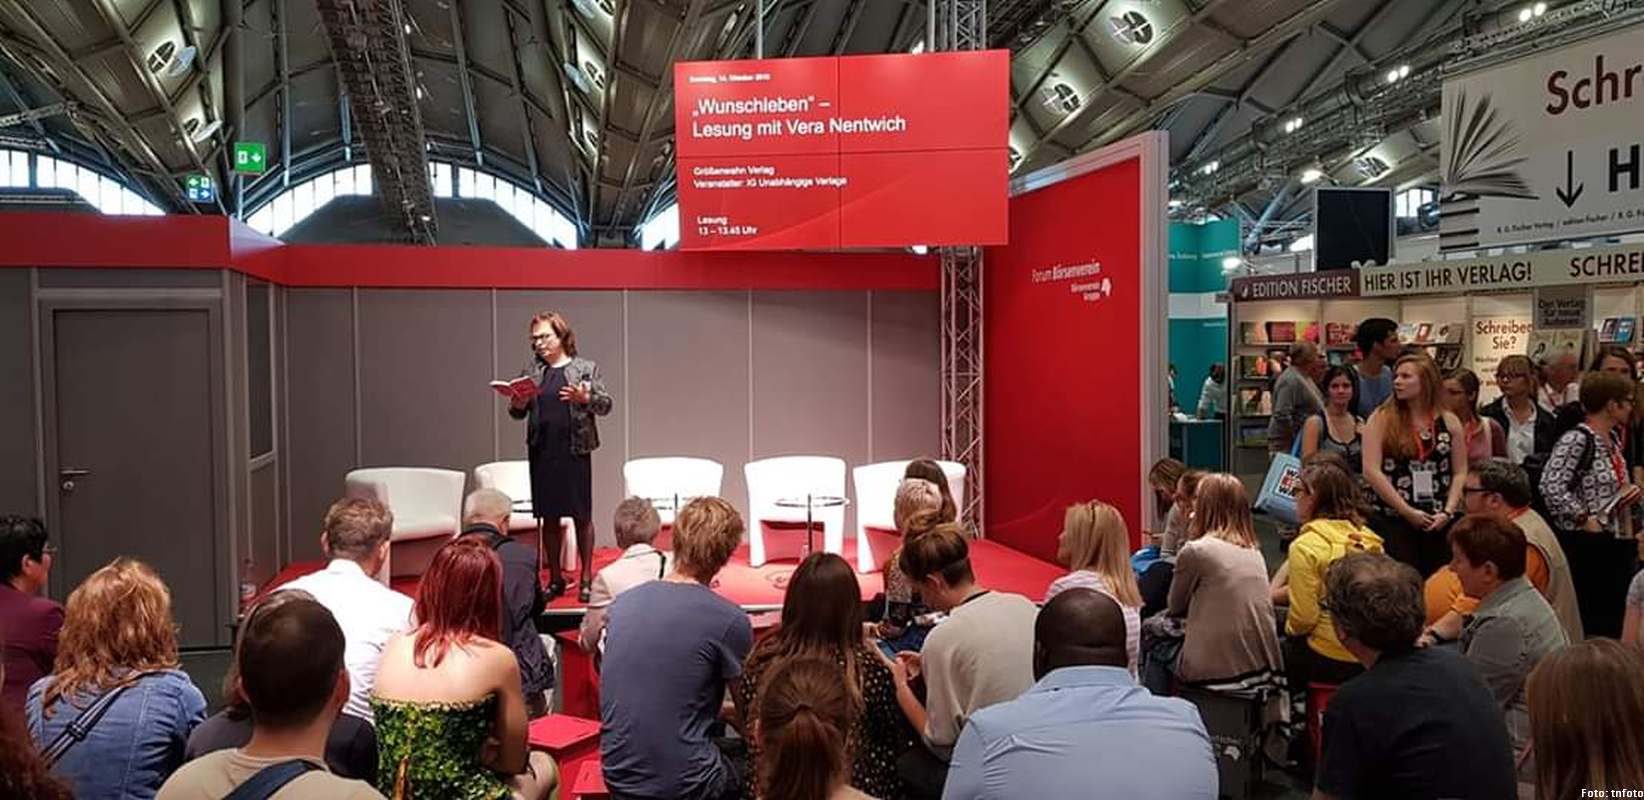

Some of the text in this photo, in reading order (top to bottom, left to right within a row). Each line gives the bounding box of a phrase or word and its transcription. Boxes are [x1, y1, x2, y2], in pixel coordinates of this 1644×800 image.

[1546, 54, 1643, 115] Schr
[692, 114, 906, 140] Lesung mit Vera Nentwich
[693, 165, 775, 177] Größenwahn Verlag
[1609, 144, 1641, 192] H
[758, 177, 813, 188] Unabhängige
[815, 176, 848, 188] Verlage
[697, 215, 728, 226] Lesung
[699, 225, 708, 235] 13
[742, 225, 757, 235] Uhr
[1032, 258, 1100, 283] Forum Börsenverein
[1364, 261, 1533, 291] HIER IST IHR VERLAG!
[1253, 276, 1352, 298] EDITION FISCHER
[1492, 335, 1517, 351] Sie?
